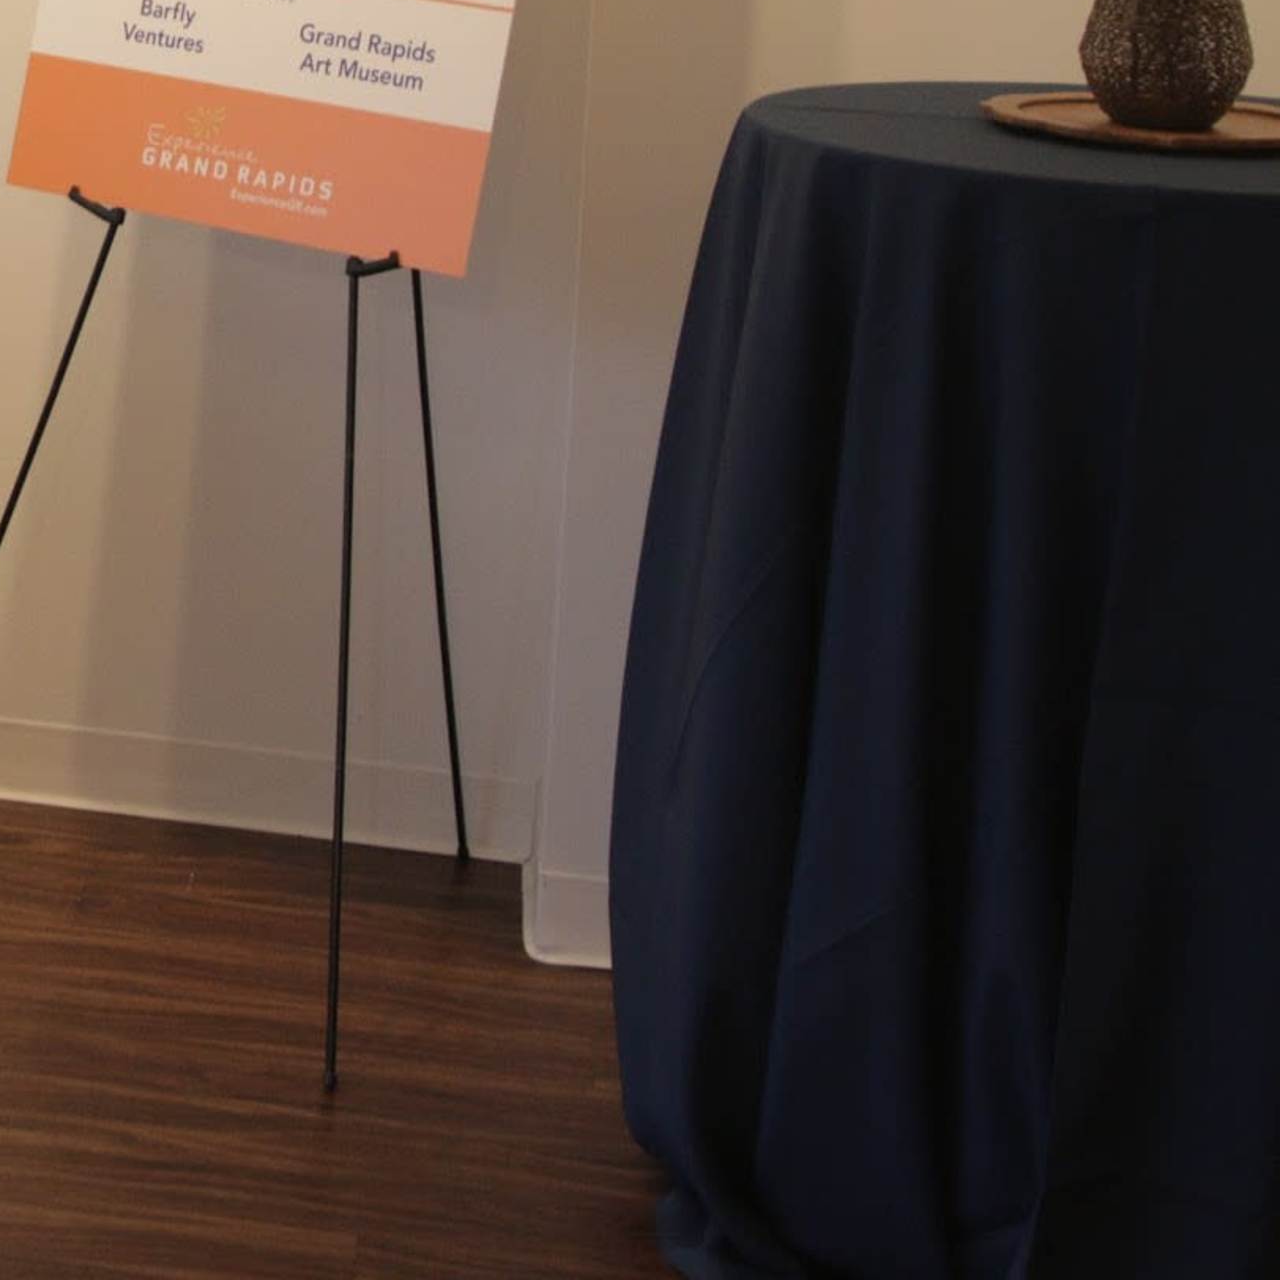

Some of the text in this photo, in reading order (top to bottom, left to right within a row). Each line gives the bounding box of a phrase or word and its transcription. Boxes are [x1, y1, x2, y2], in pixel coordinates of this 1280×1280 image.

[123, 21, 203, 54] Ventures
[299, 23, 436, 63] Grand Rapids
[299, 53, 424, 91] Art Museum
[147, 123, 257, 163] Experience
[142, 146, 333, 200] GRAND RAPIDS
